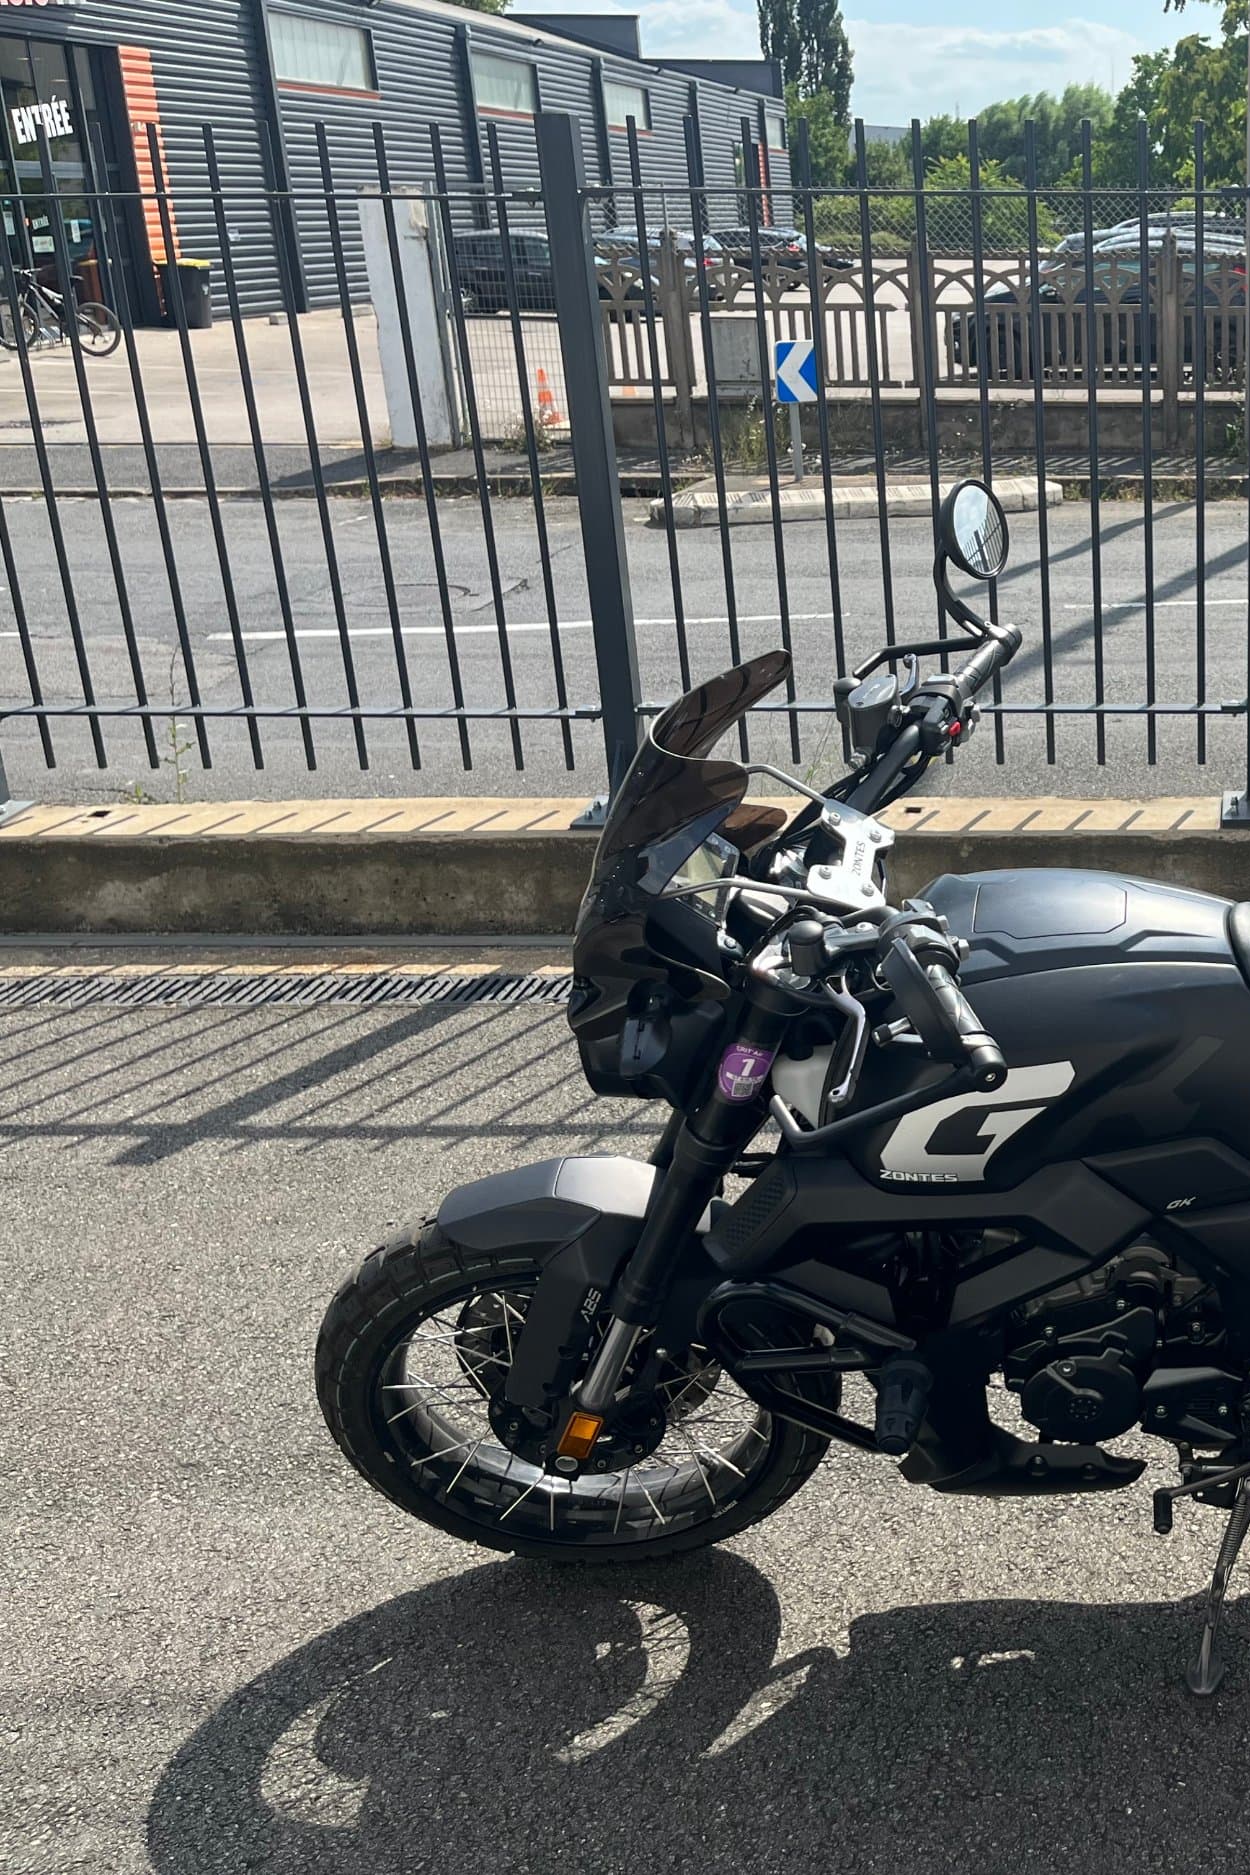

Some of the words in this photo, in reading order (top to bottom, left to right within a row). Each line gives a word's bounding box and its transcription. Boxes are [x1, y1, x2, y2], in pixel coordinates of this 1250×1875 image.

[851, 840, 866, 876] ZONTES
[741, 1058, 756, 1077] 1
[879, 1169, 958, 1183] ZONTES
[580, 1287, 602, 1324] ABS
